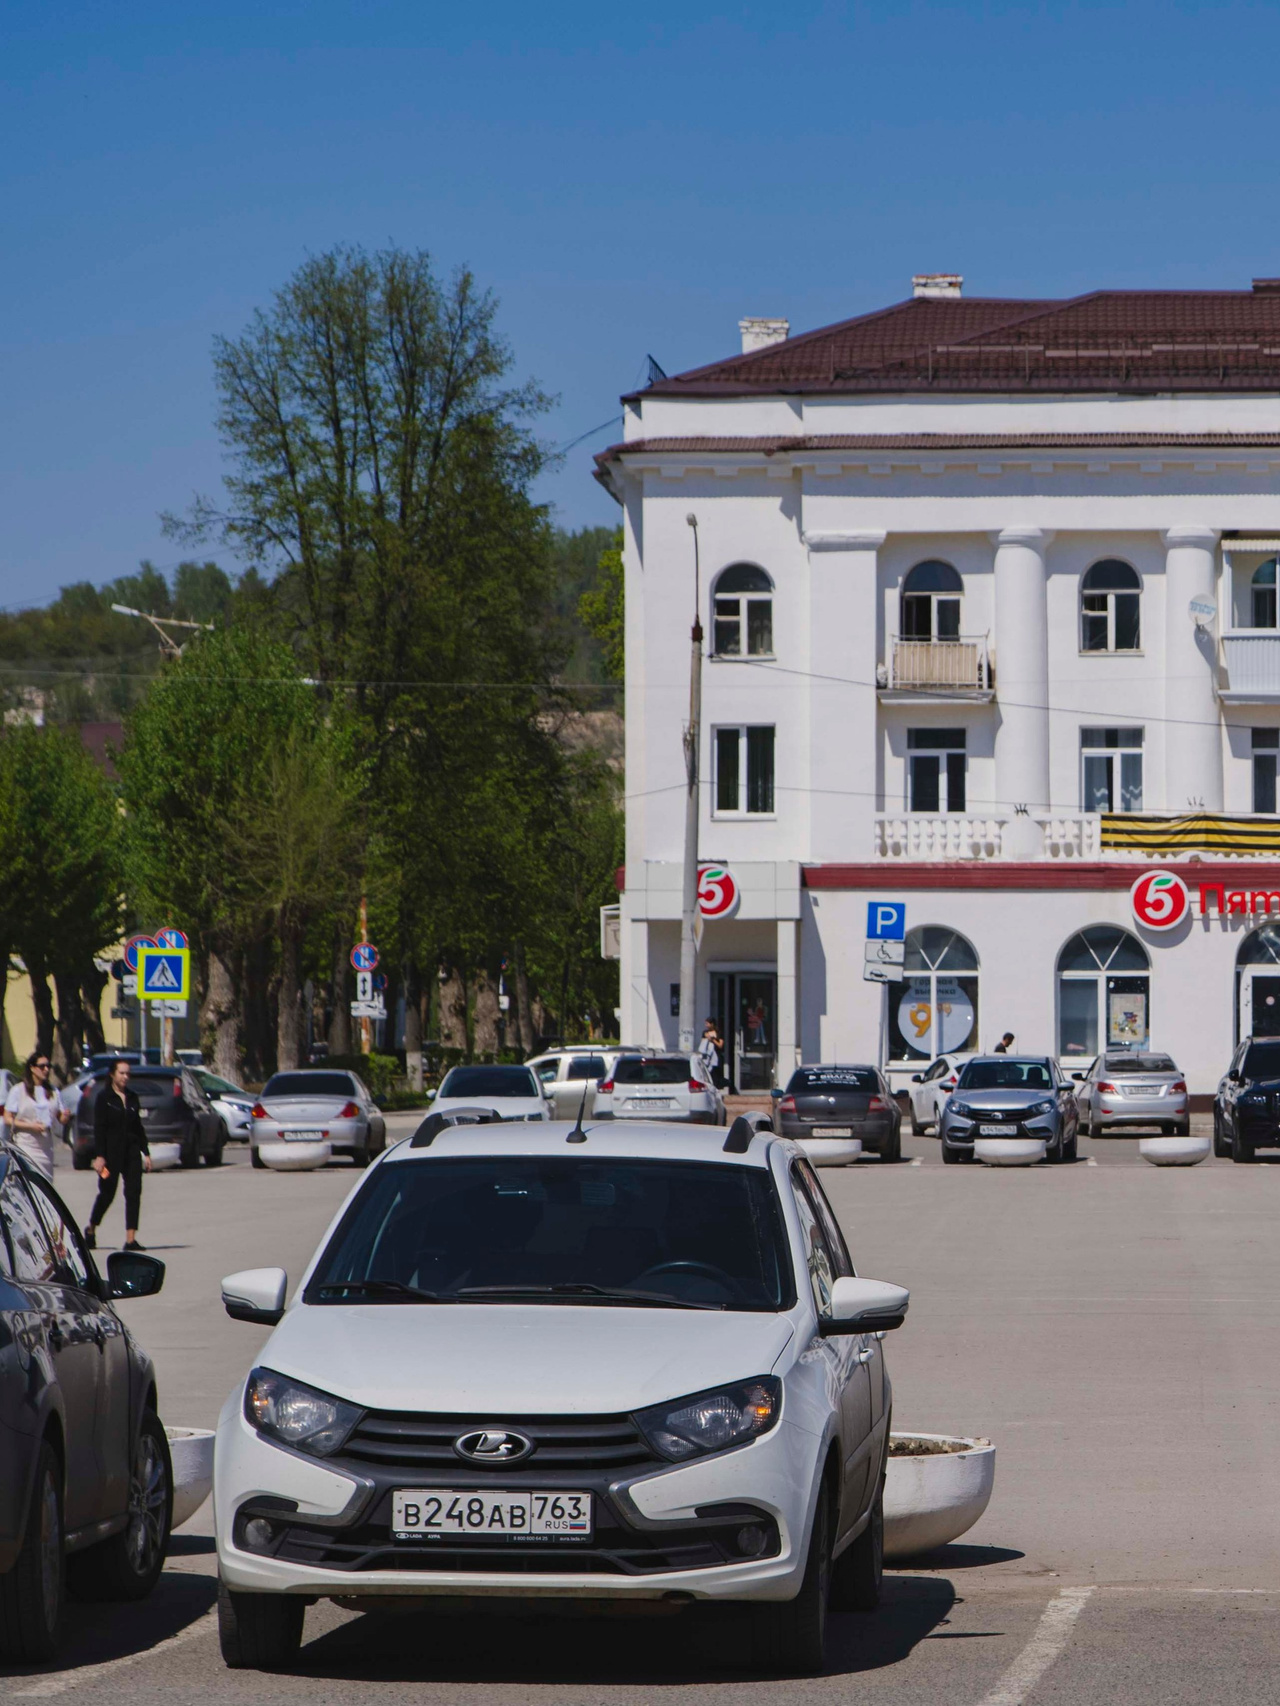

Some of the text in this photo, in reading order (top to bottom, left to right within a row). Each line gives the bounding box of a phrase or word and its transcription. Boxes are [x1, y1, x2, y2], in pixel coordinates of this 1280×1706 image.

[876, 906, 898, 935] P
[404, 1496, 583, 1528] В248АВ 763
[545, 1520, 569, 1530] RUS
